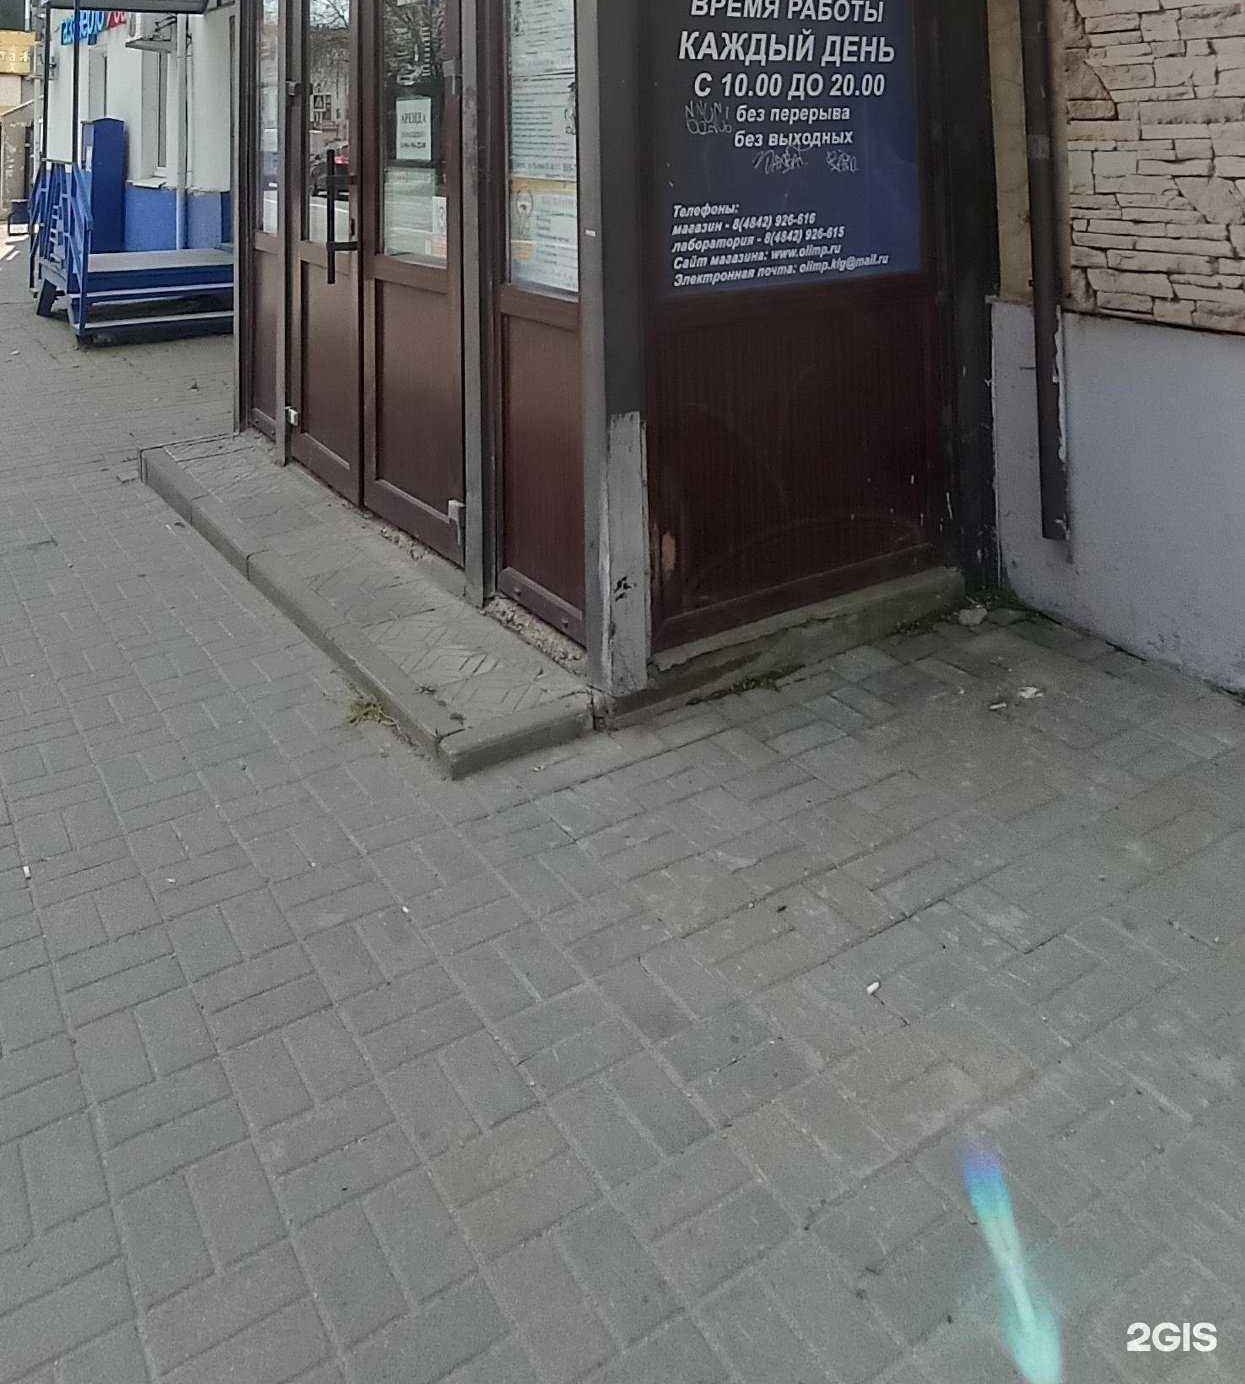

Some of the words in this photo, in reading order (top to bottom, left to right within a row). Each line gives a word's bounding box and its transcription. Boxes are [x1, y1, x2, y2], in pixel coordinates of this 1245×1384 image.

[678, 28, 816, 66] КАЖДЫЙ
[821, 35, 895, 67] ДЕНЬ
[694, 72, 713, 97] С
[721, 72, 782, 97] 10.00
[788, 73, 824, 100] ДО
[829, 73, 885, 97] 20.00
[736, 104, 765, 122] без
[770, 106, 851, 124] перерыва
[734, 129, 763, 147] без
[768, 130, 853, 148] выходных
[672, 220, 723, 235] магазин
[732, 215, 773, 233] 8(4842)
[774, 212, 817, 228] 926-616
[673, 203, 740, 218] Телефоны:
[672, 235, 754, 253] лаборатория
[764, 230, 803, 247] 8(4842)
[805, 226, 846, 241] 926-615
[674, 255, 707, 270] Сайт
[709, 251, 768, 266] магазина:
[771, 244, 842, 260] www.olimp.ru
[674, 271, 754, 287] Электронная
[757, 265, 797, 279] почта:
[799, 253, 889, 274] olimp.klg@mail.ru
